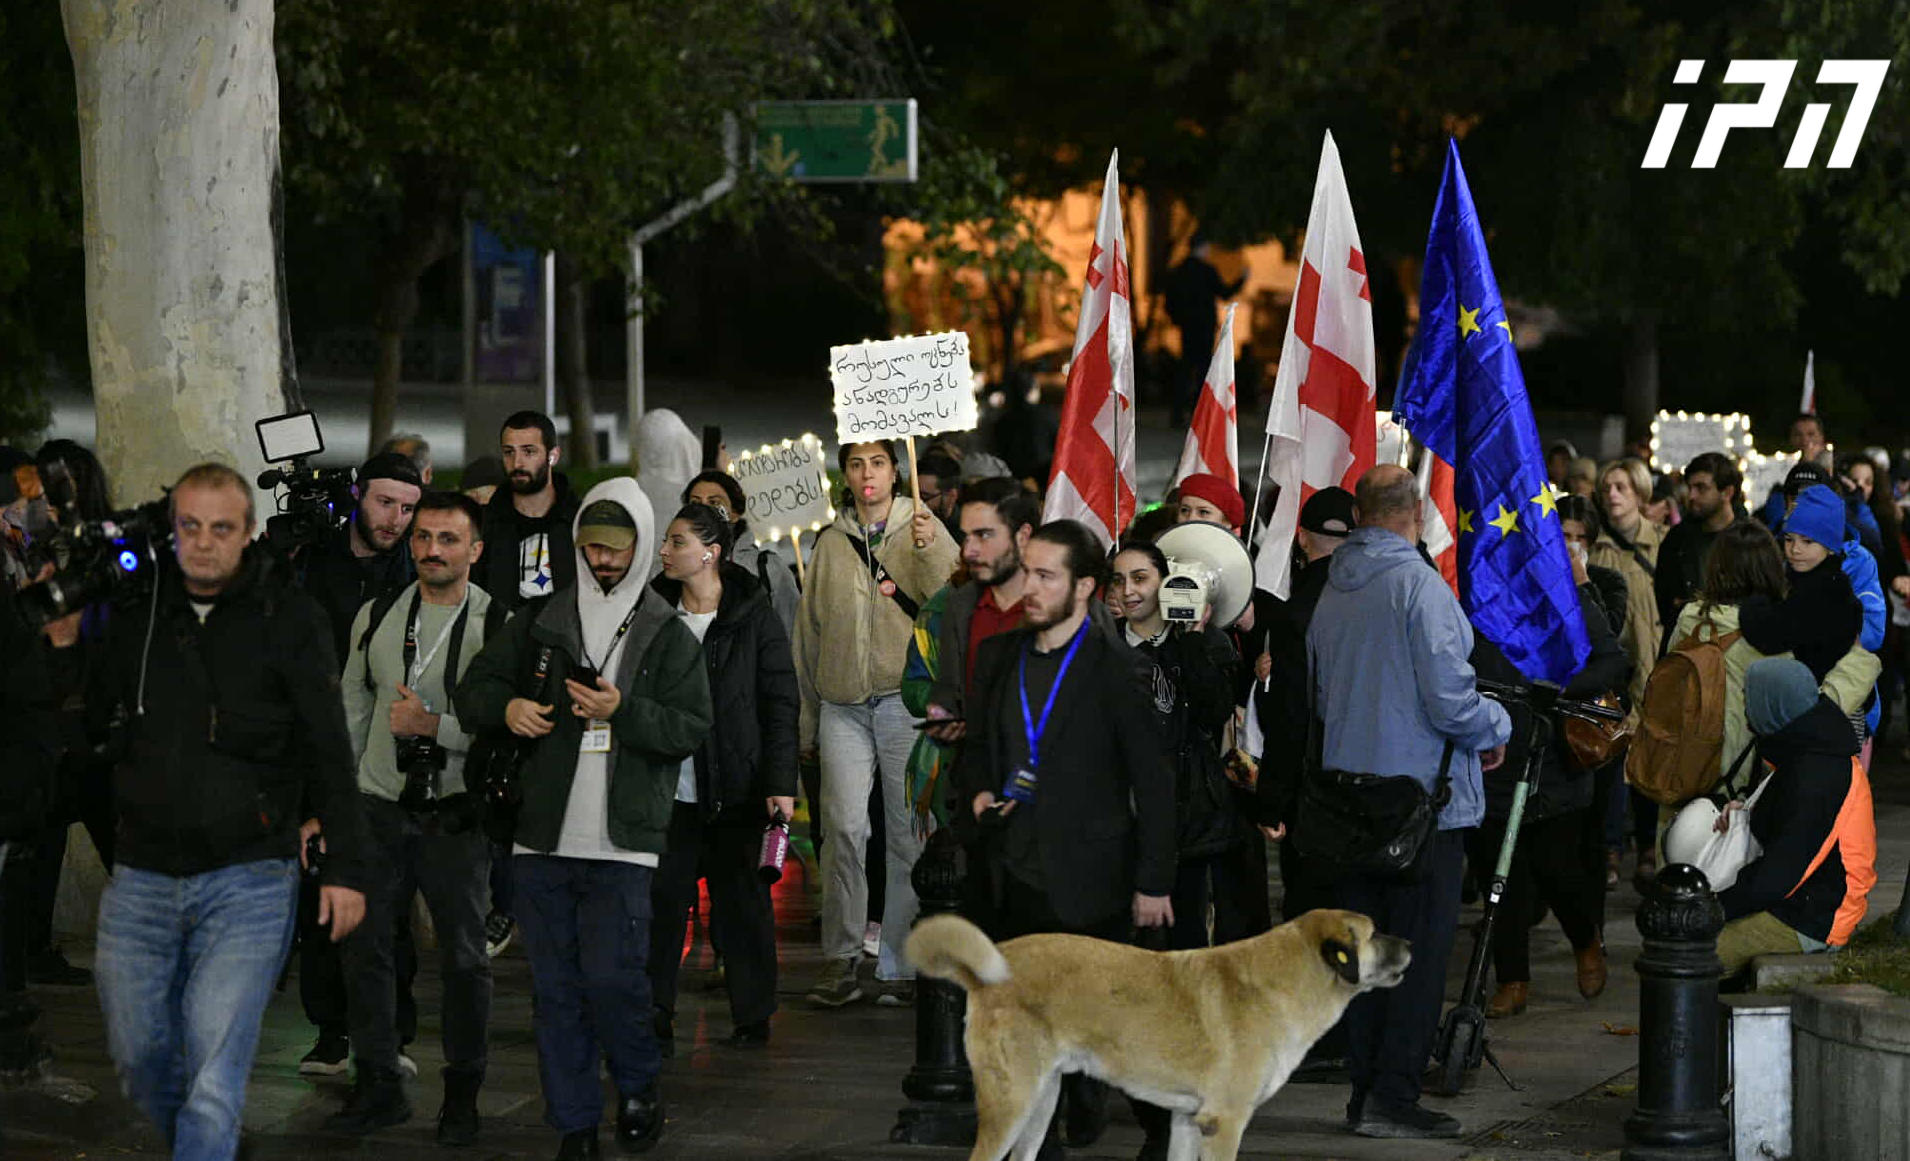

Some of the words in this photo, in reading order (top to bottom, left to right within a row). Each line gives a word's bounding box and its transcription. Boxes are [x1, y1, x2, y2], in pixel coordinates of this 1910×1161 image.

[836, 348, 915, 383] რუსული
[842, 372, 958, 406] ანადგურებს
[848, 399, 958, 435] მომავალს!
[747, 470, 825, 522] დედებს!
